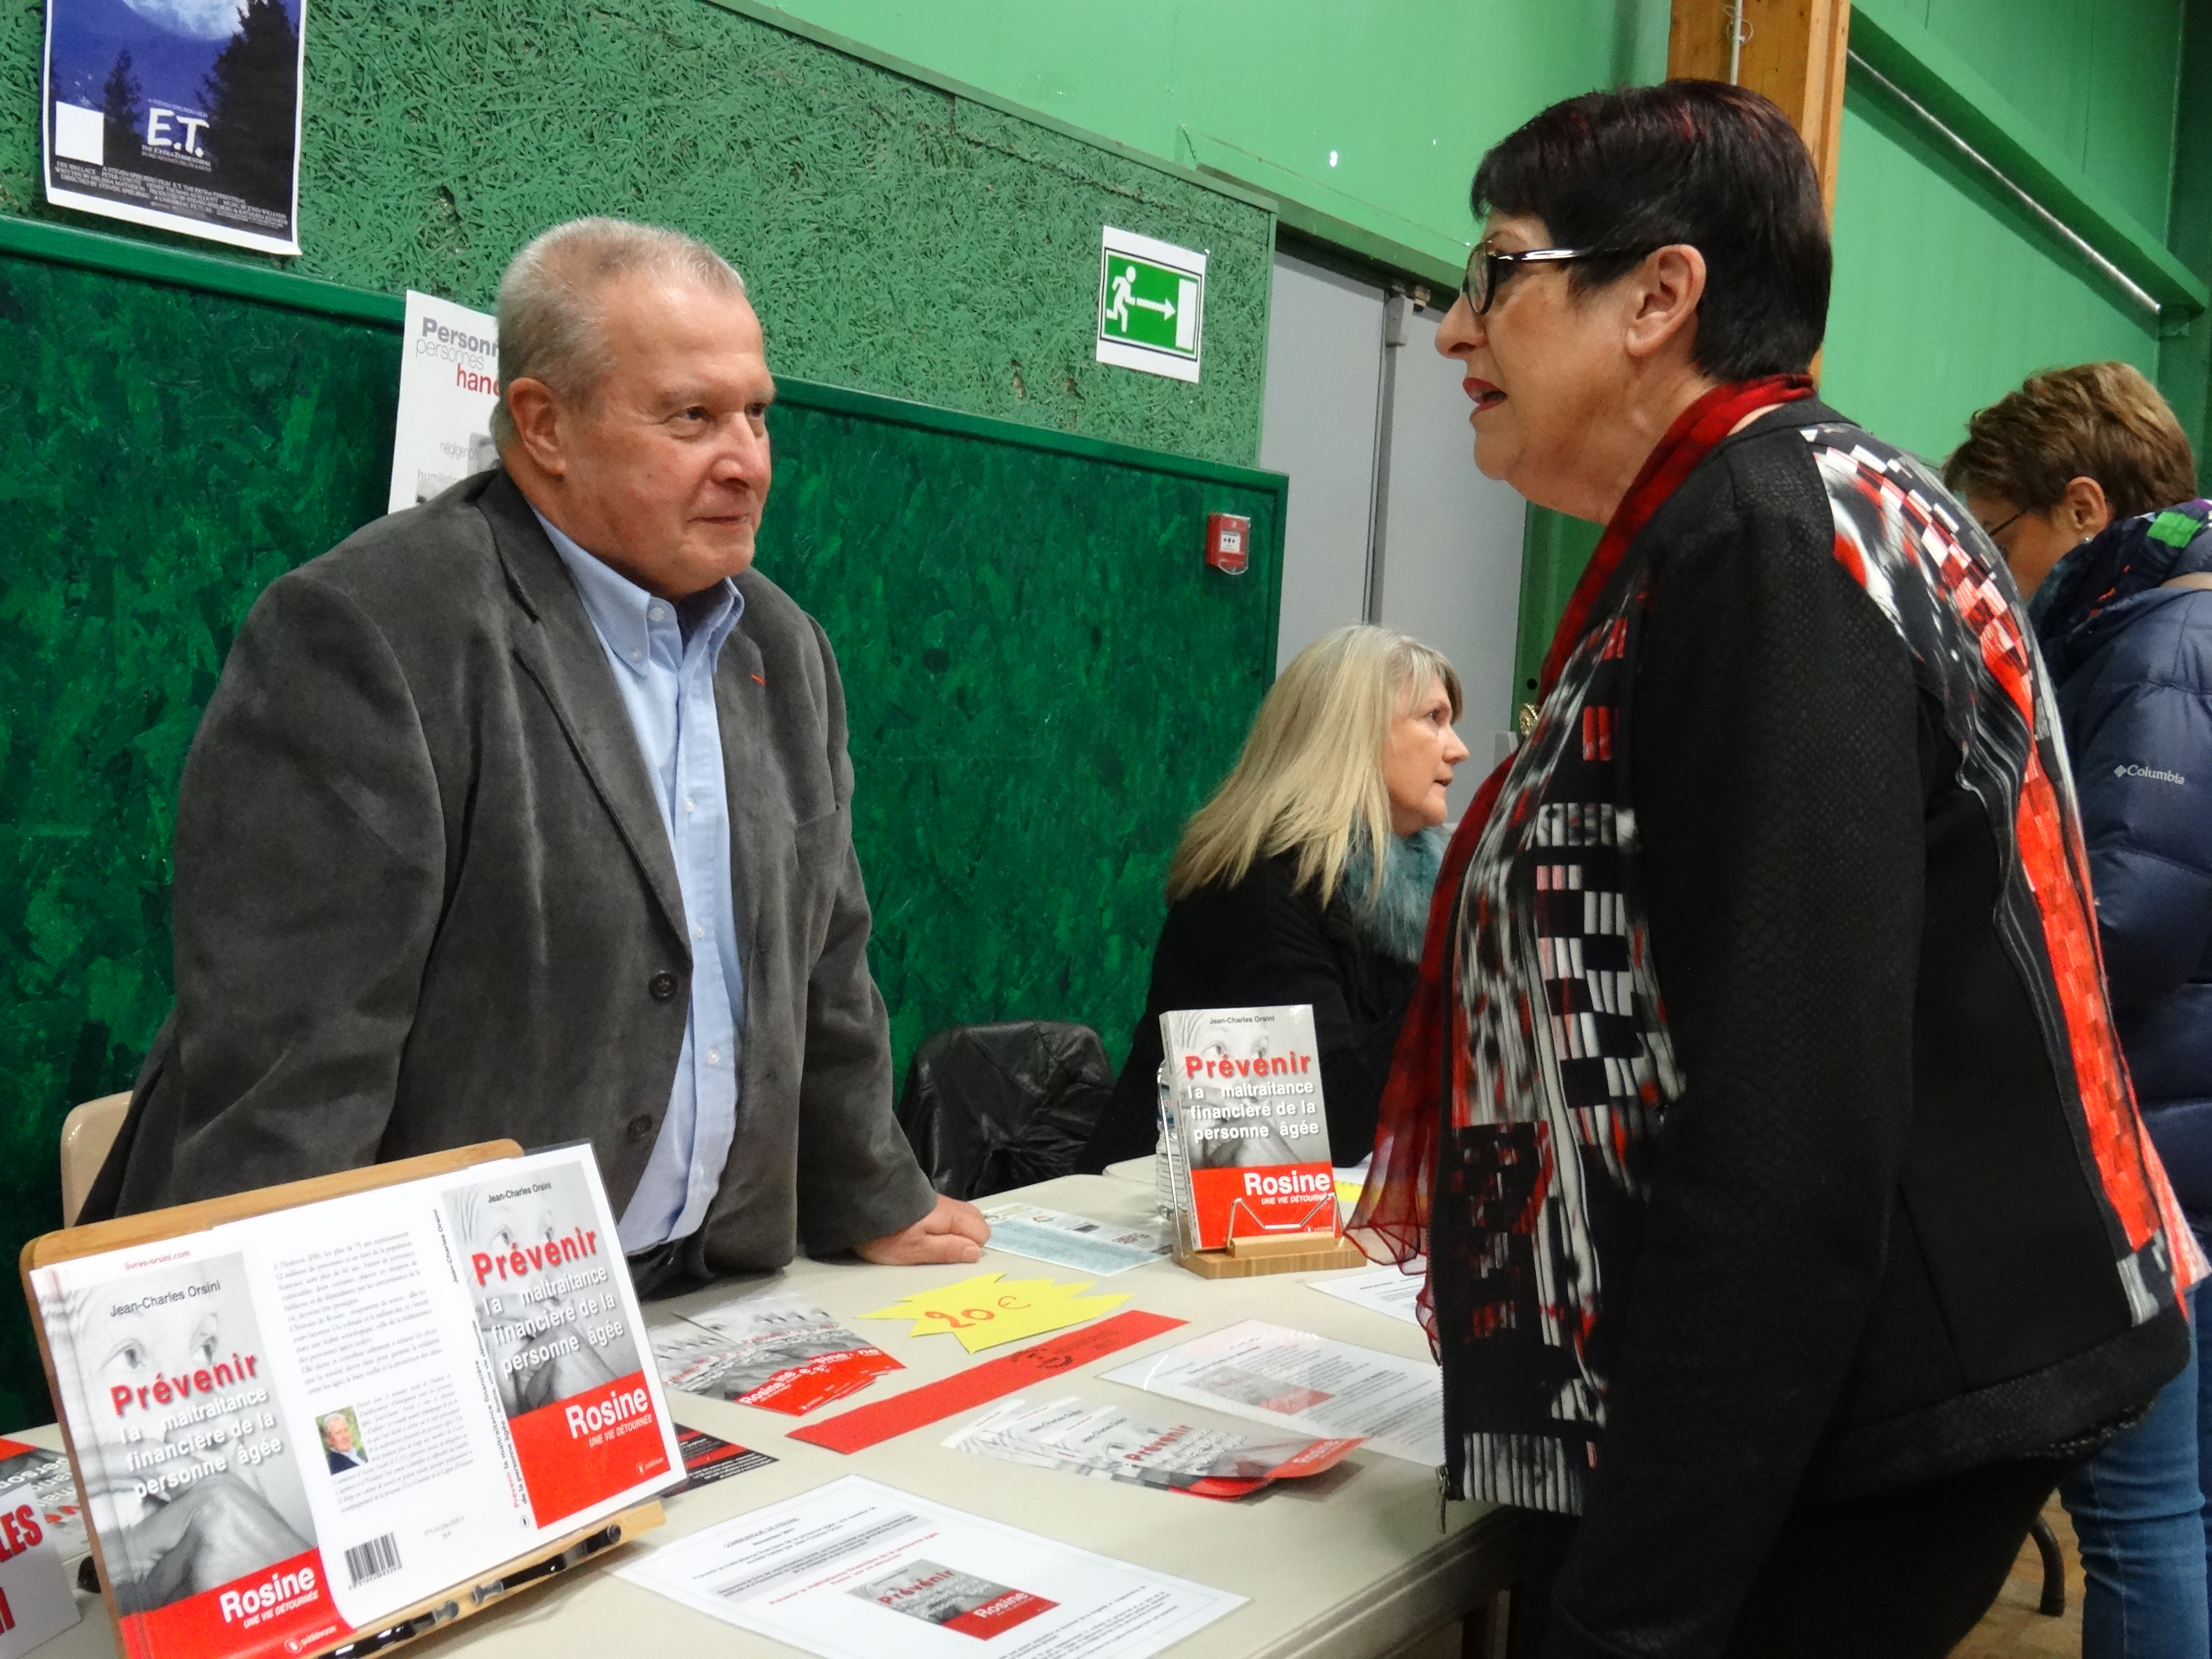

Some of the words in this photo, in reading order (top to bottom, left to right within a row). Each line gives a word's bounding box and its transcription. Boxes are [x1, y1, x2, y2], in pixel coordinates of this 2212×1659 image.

[147, 108, 210, 158] E.T.
[416, 339, 484, 370] personnes
[2127, 765, 2185, 784] Columbia
[1185, 1051, 1311, 1080] Prévenir
[1187, 1085, 1204, 1099] la
[1221, 1081, 1314, 1098] maltraitance
[1190, 1103, 1271, 1120] financière
[1276, 1101, 1296, 1116] de
[1301, 1100, 1316, 1114] la
[1193, 1125, 1269, 1144] personne
[1280, 1120, 1319, 1139] âgée
[488, 1187, 532, 1204] Jean-Charles
[1244, 1170, 1330, 1196] Rosine
[1261, 1197, 1275, 1205] UNE
[1278, 1196, 1288, 1204] VIE
[1290, 1193, 1331, 1203] DÉTOURNÉ
[125, 1251, 190, 1271] livres-orsini.com
[472, 1226, 596, 1286] Prévenir
[110, 1291, 185, 1317] Jean-Charles
[188, 1280, 221, 1298] Orsini
[483, 1297, 503, 1316] la
[521, 1266, 608, 1306] maltraitance
[491, 1306, 576, 1346] financière
[579, 1298, 599, 1318] de
[599, 1292, 617, 1311] la
[501, 1335, 580, 1380] personne
[587, 1319, 624, 1347] âgée
[110, 1352, 257, 1417] Prévenir
[121, 1426, 142, 1444] la
[163, 1388, 268, 1432] maltraitance
[565, 1388, 649, 1440] Rosine
[588, 1434, 604, 1448] UNE
[604, 1429, 615, 1441] VIE
[616, 1413, 653, 1436] DÉTOURNÉE
[128, 1427, 226, 1472] financière
[230, 1419, 253, 1438] de
[257, 1412, 275, 1429] la
[134, 1455, 228, 1503] personne
[237, 1437, 282, 1465] âgée
[219, 1566, 315, 1623] Rosine
[973, 1592, 1030, 1618] Rosine
